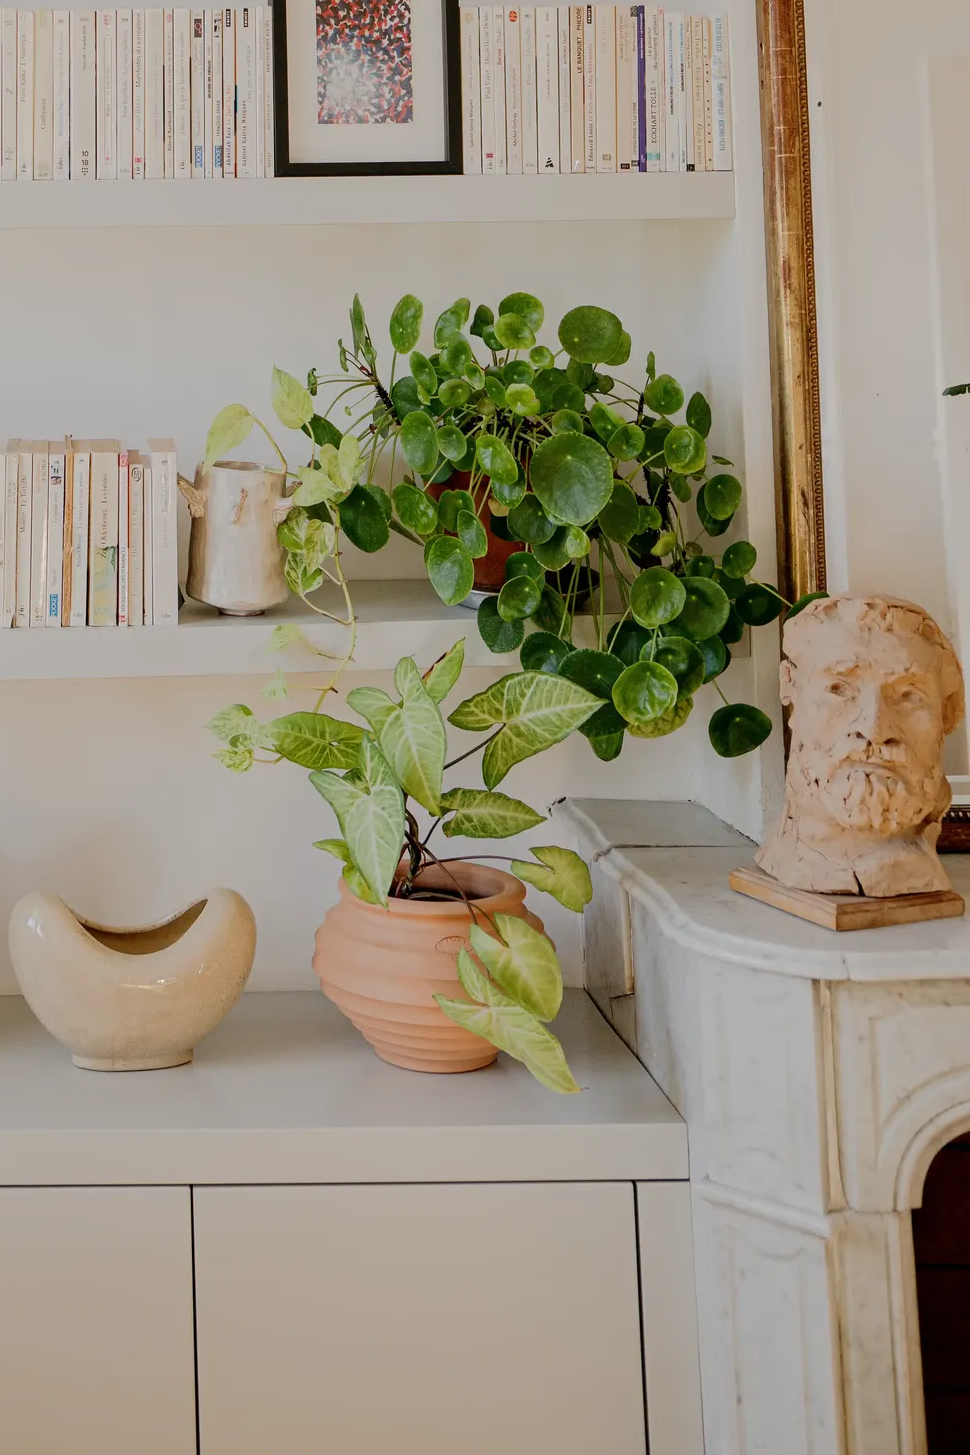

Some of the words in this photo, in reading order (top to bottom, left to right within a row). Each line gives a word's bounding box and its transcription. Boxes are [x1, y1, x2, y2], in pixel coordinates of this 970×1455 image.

[576, 66, 582, 74] LE
[650, 110, 658, 144] ECKHART
[50, 594, 58, 617] POCKET
